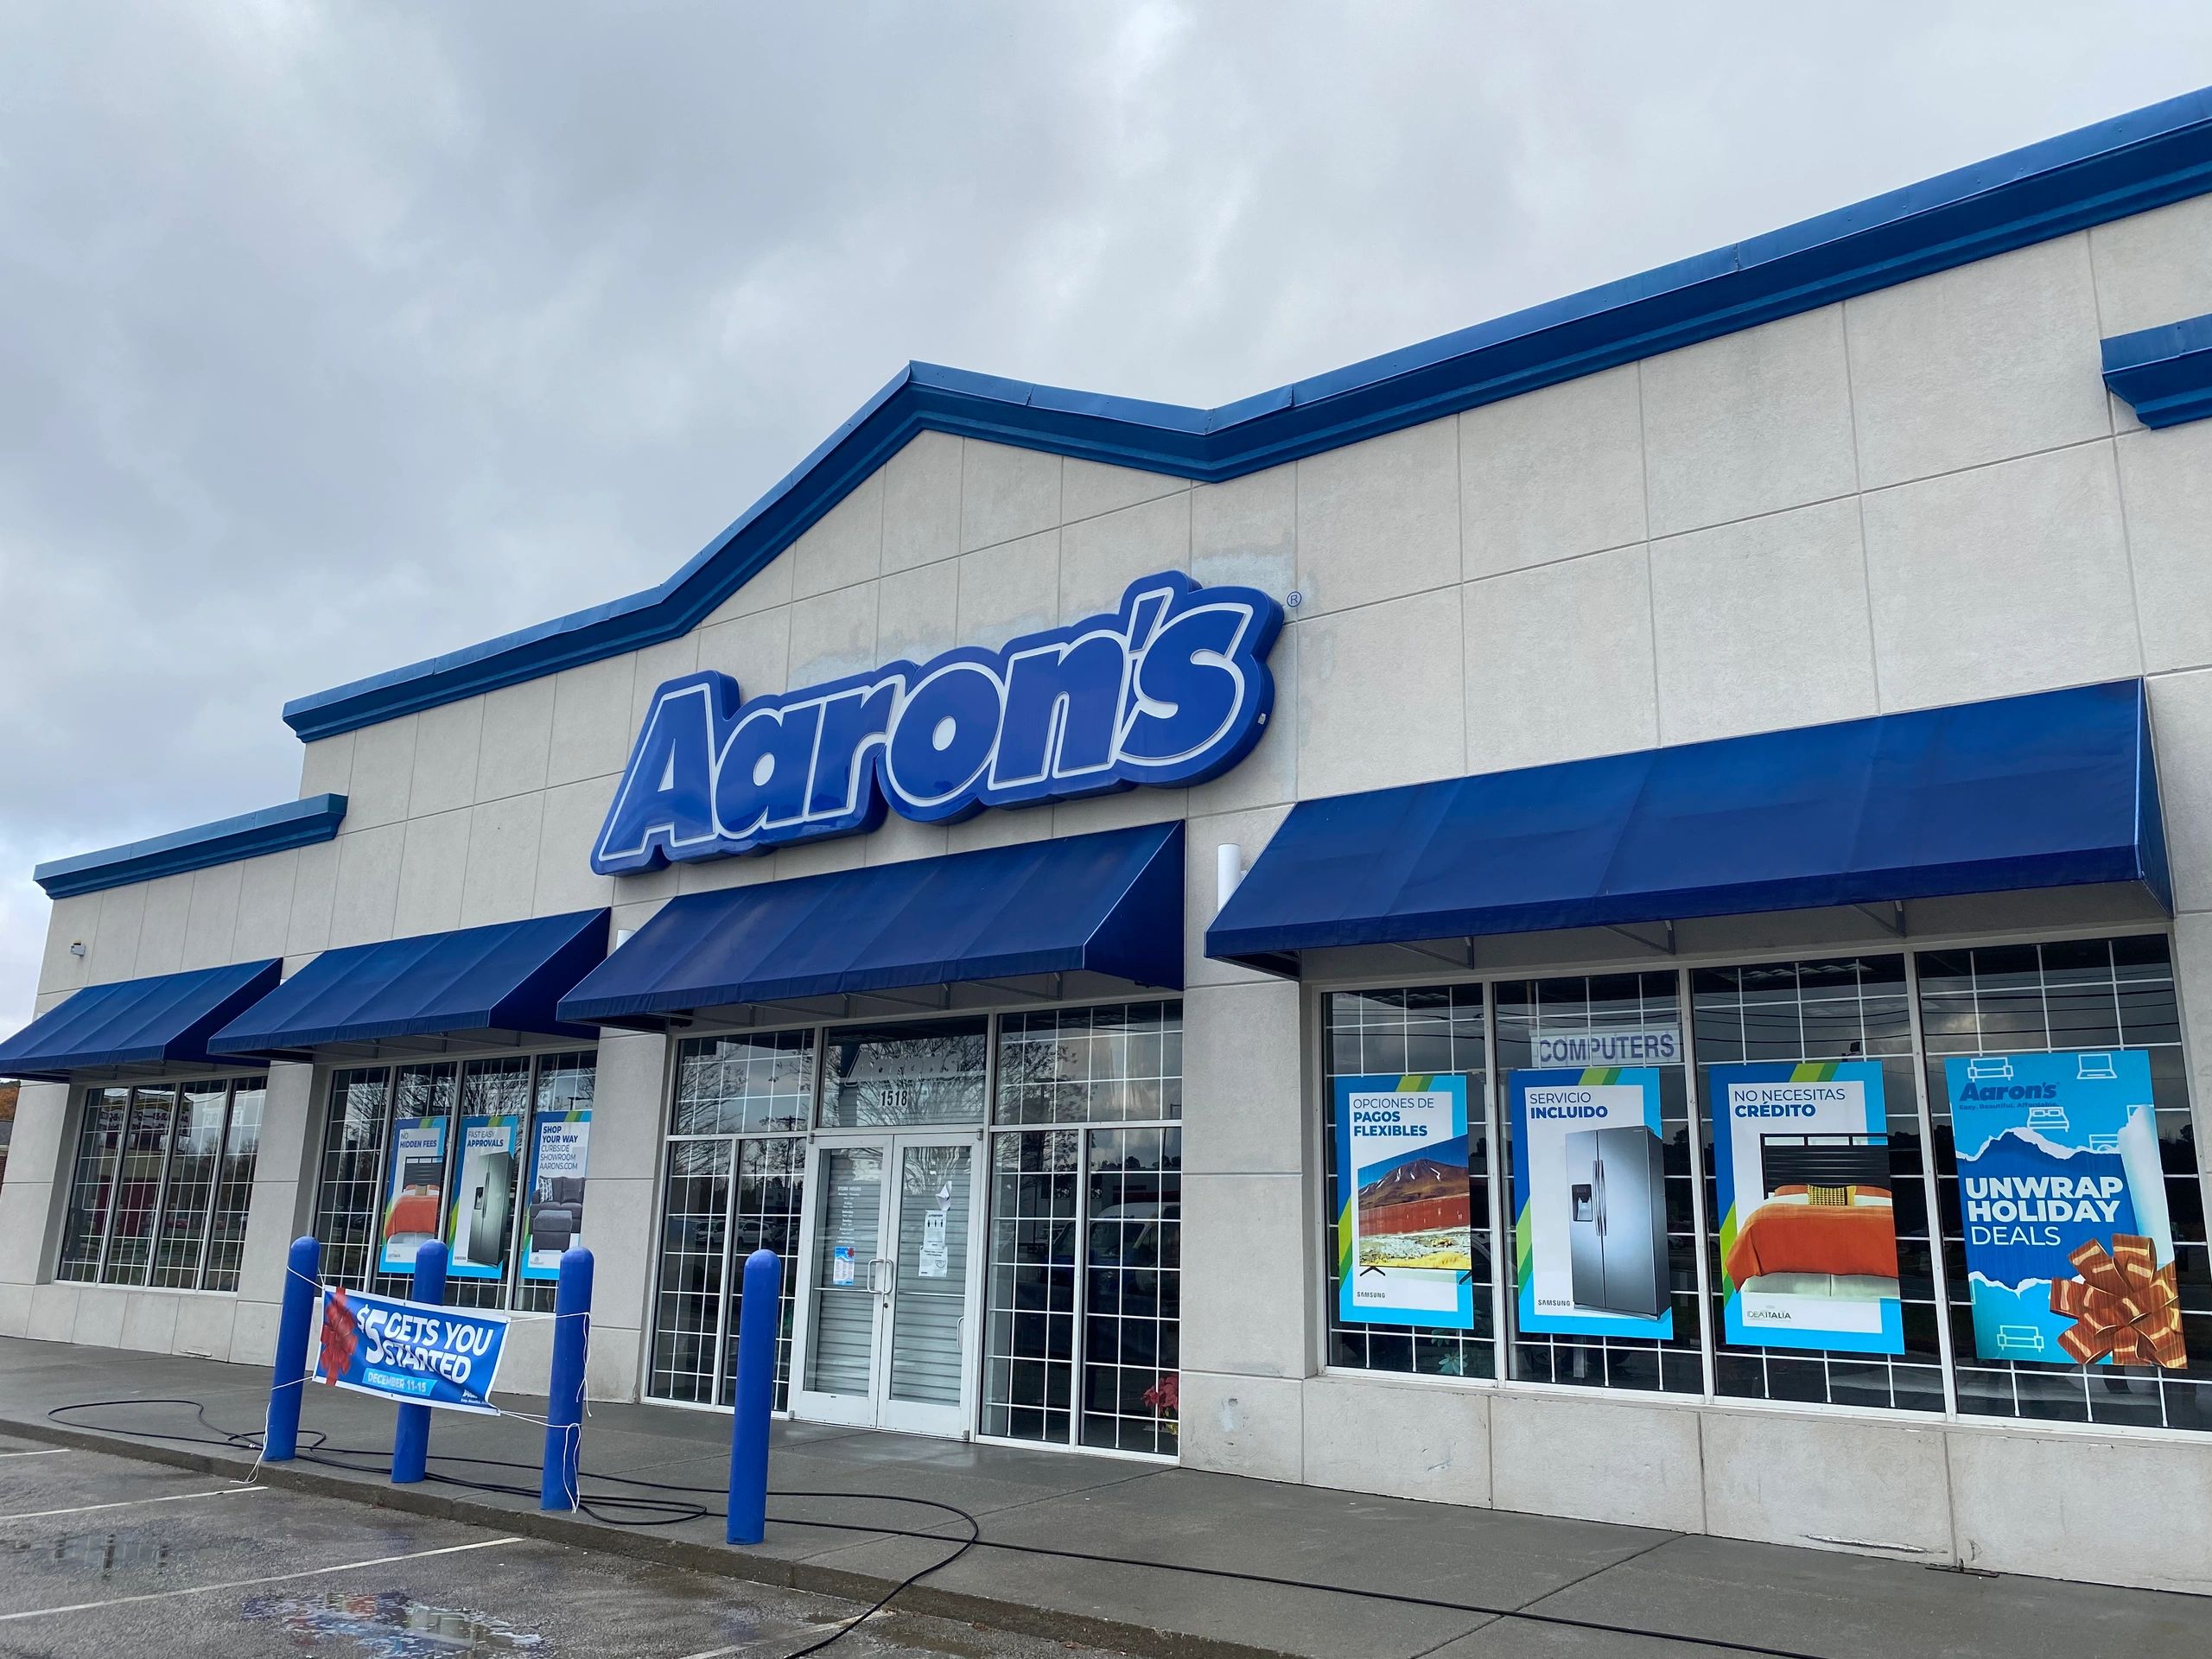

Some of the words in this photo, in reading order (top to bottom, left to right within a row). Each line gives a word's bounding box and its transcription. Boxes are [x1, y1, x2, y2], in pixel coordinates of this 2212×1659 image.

[594, 586, 1255, 862] Aaron's
[1539, 1034, 1675, 1062] COMPUTERS
[880, 1090, 908, 1107] 1518
[1529, 1091, 1592, 1104] SERVICIO
[1734, 1090, 1758, 1102] NO
[1762, 1088, 1846, 1102] NECESITAS
[1959, 1082, 2056, 1101] Aaron's
[1353, 1098, 1414, 1109] OPCIONES
[1417, 1097, 1434, 1109] DE
[1734, 1101, 1816, 1118] CRÉDITO
[1353, 1110, 1401, 1122] PAGOS
[1530, 1105, 1608, 1119] INCLUIDO
[467, 1130, 481, 1139] FAST
[480, 1130, 495, 1139] EASY
[543, 1125, 562, 1134] SHOP
[1354, 1125, 1428, 1137] FLEXIBLES
[399, 1140, 422, 1148] HIDDEN
[467, 1139, 505, 1147] APPROVALS
[542, 1135, 561, 1143] YOUR
[562, 1135, 579, 1143] WAY
[541, 1144, 570, 1153] CURBSIDE
[540, 1153, 576, 1161] SHOWROOM
[1965, 1176, 2124, 1199] UNWRAP
[1967, 1200, 2121, 1223] HOLIDAY
[1971, 1226, 2062, 1246] DEALS
[384, 1312, 441, 1346] GETS
[443, 1321, 494, 1357] YOU
[382, 1339, 472, 1384] STARTED
[367, 1372, 404, 1389] DECEMBER
[406, 1380, 427, 1393] 11-15
